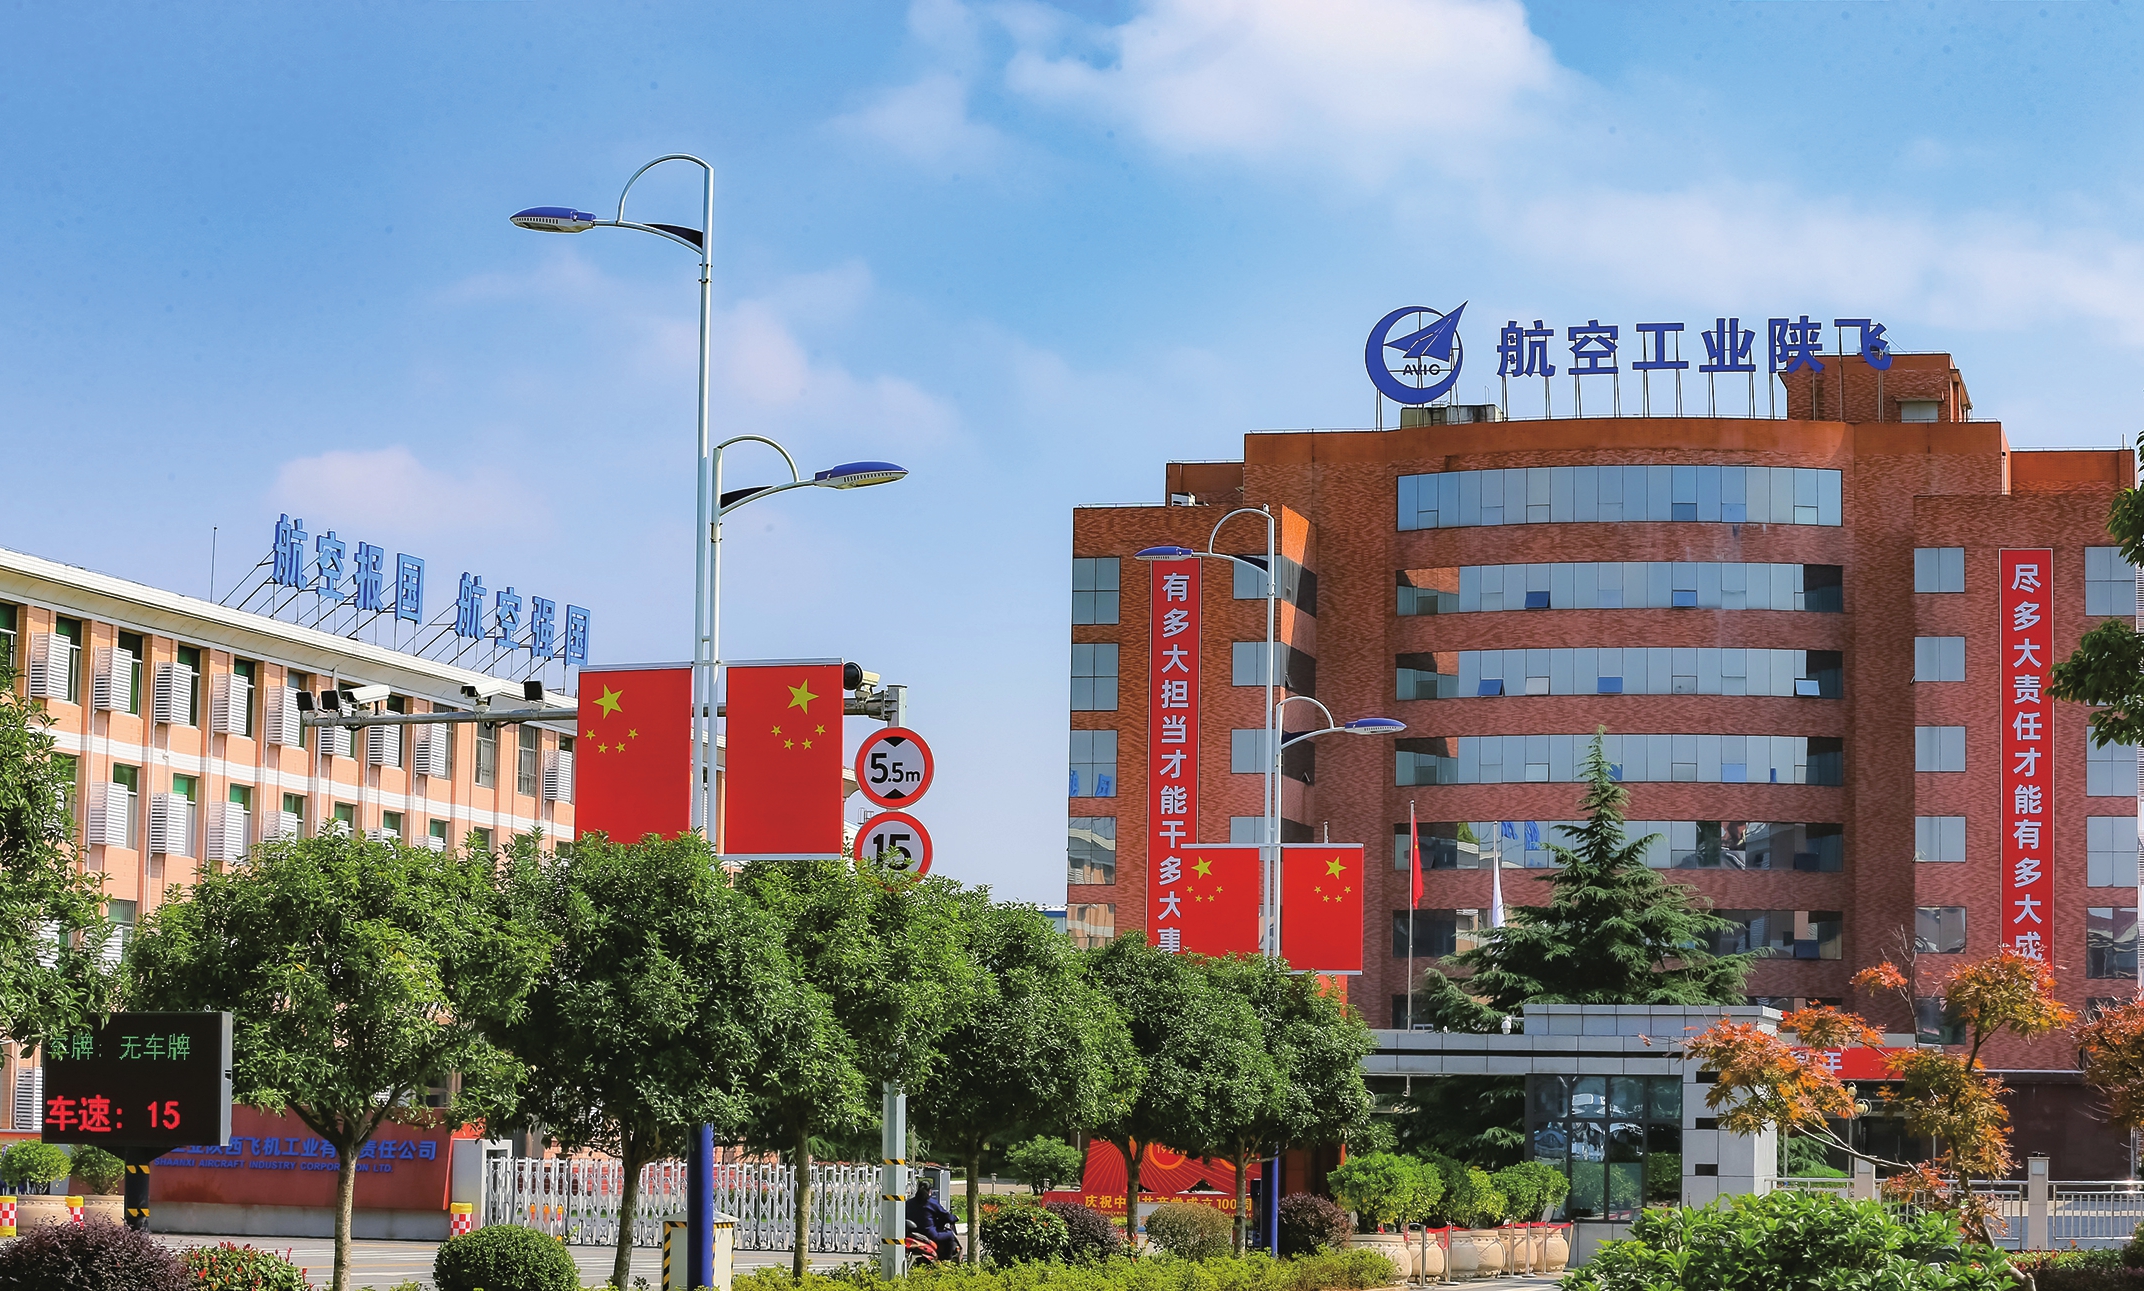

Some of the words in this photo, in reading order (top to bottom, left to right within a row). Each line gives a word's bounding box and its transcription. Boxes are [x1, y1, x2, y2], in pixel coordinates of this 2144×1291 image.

[1496, 314, 1893, 378] 航空工业陕飞
[272, 513, 425, 625] 航空报国
[454, 571, 591, 667] 航空强国
[870, 752, 921, 784] 5.5m
[1157, 572, 1190, 954] 有多大担当才能干多大事
[2011, 563, 2043, 961] 尽多大责任才能有多大成
[872, 833, 912, 871] 15
[118, 1033, 191, 1061] 无车牌
[45, 1094, 123, 1132] 车速：
[147, 1101, 181, 1130] 15
[154, 1157, 195, 1167] SHAANXI
[198, 1159, 245, 1169] AIRCRAFT
[249, 1160, 296, 1170] INDUSTRY
[300, 1161, 369, 1172] CORPORON
[373, 1164, 393, 1173] LTD.
[170, 1136, 437, 1161] 西飞机工业有责任公司
